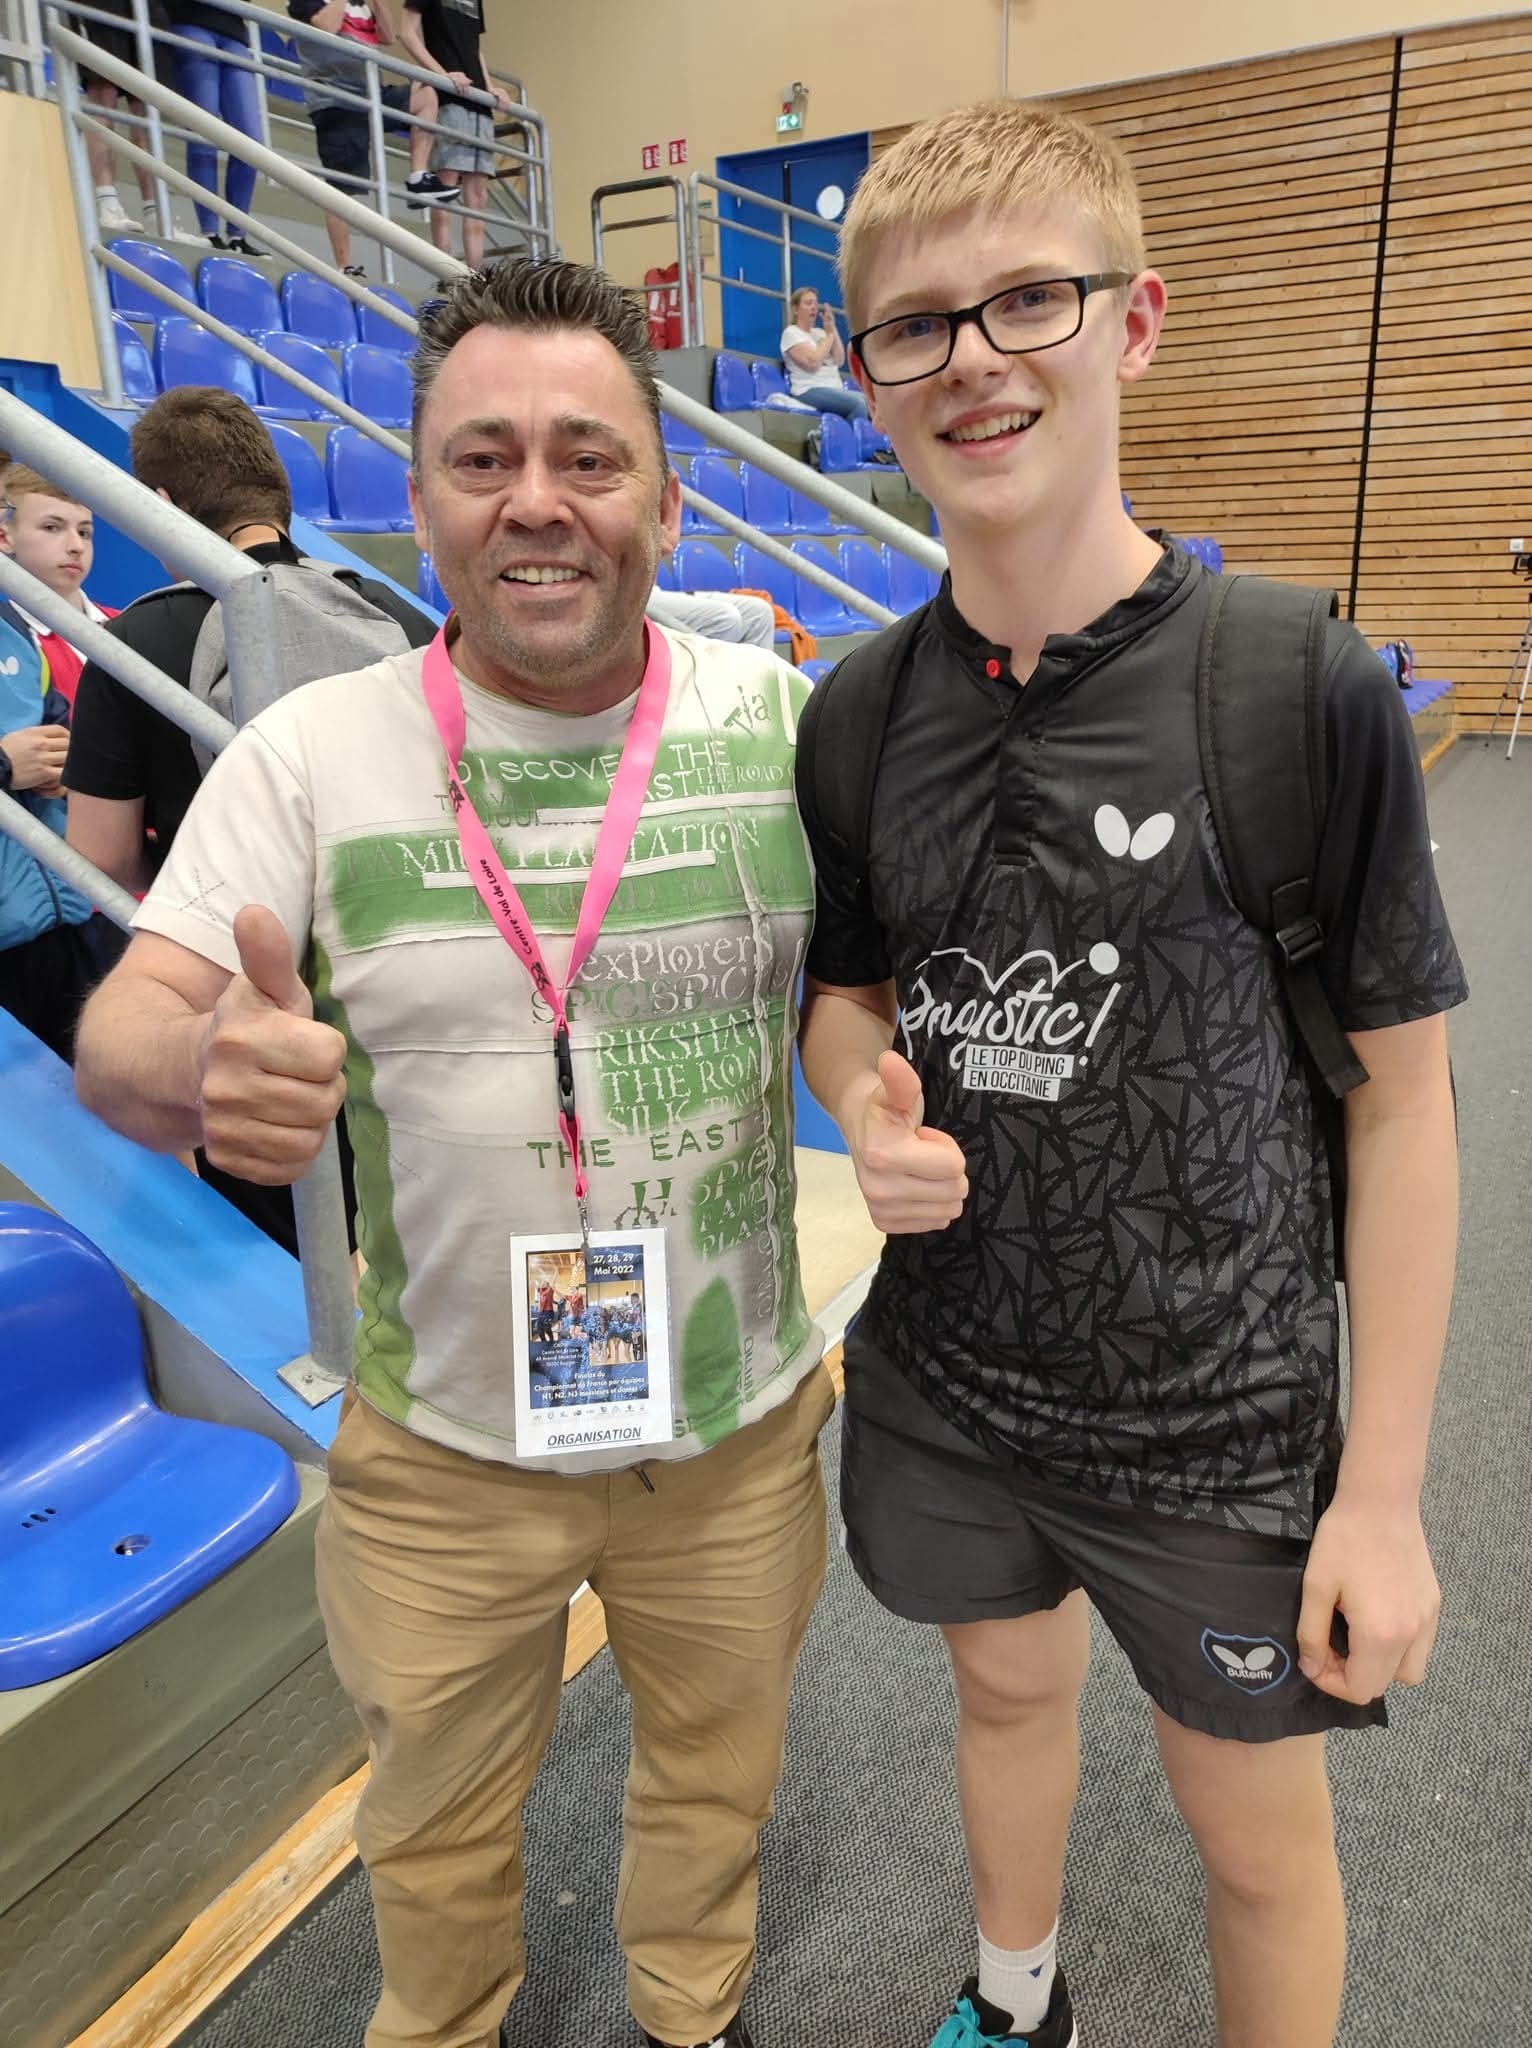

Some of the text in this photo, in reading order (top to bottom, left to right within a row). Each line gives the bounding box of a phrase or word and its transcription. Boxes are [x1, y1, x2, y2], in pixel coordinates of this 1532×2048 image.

[457, 740, 730, 785] DISCOVE THE
[971, 1047, 1065, 1076] LE TOP DU PING
[600, 1063, 692, 1106] THE
[969, 1069, 1051, 1098] EN OCCITANIE
[526, 1119, 743, 1169] THE EAST
[594, 1264, 634, 1276] Mai 2022
[623, 1252, 634, 1262] 29
[547, 1426, 642, 1447] ORGANISATION
[1226, 1666, 1273, 1680] Butterfly
